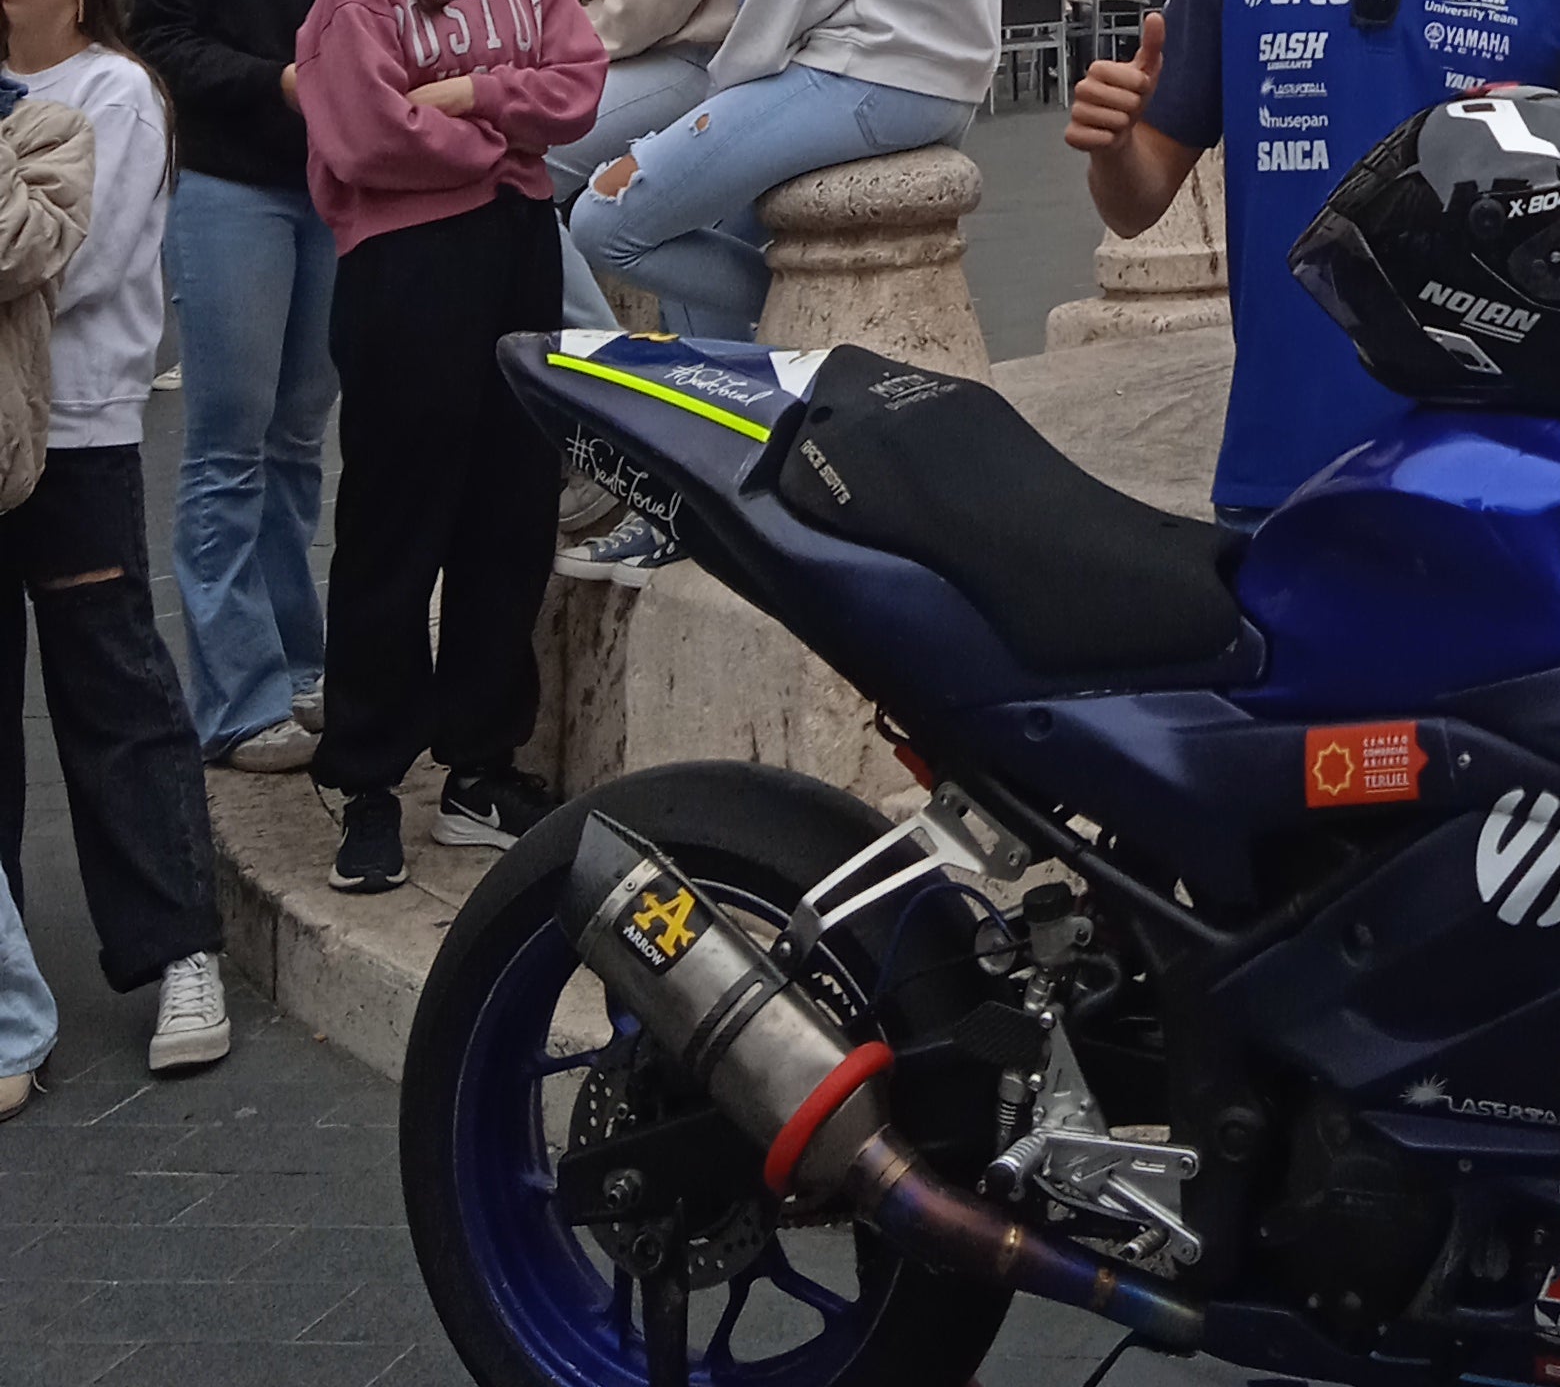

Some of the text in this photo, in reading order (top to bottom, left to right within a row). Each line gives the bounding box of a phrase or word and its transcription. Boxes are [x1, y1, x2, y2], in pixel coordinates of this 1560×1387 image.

[1424, 0, 1518, 26] University Team
[1259, 32, 1329, 62] SASH
[1446, 25, 1510, 56] YAMAHA
[1268, 114, 1329, 131] musepan
[1257, 139, 1330, 172] SAICA
[1418, 280, 1542, 341] NOLAN
[622, 924, 666, 966] ARROW
